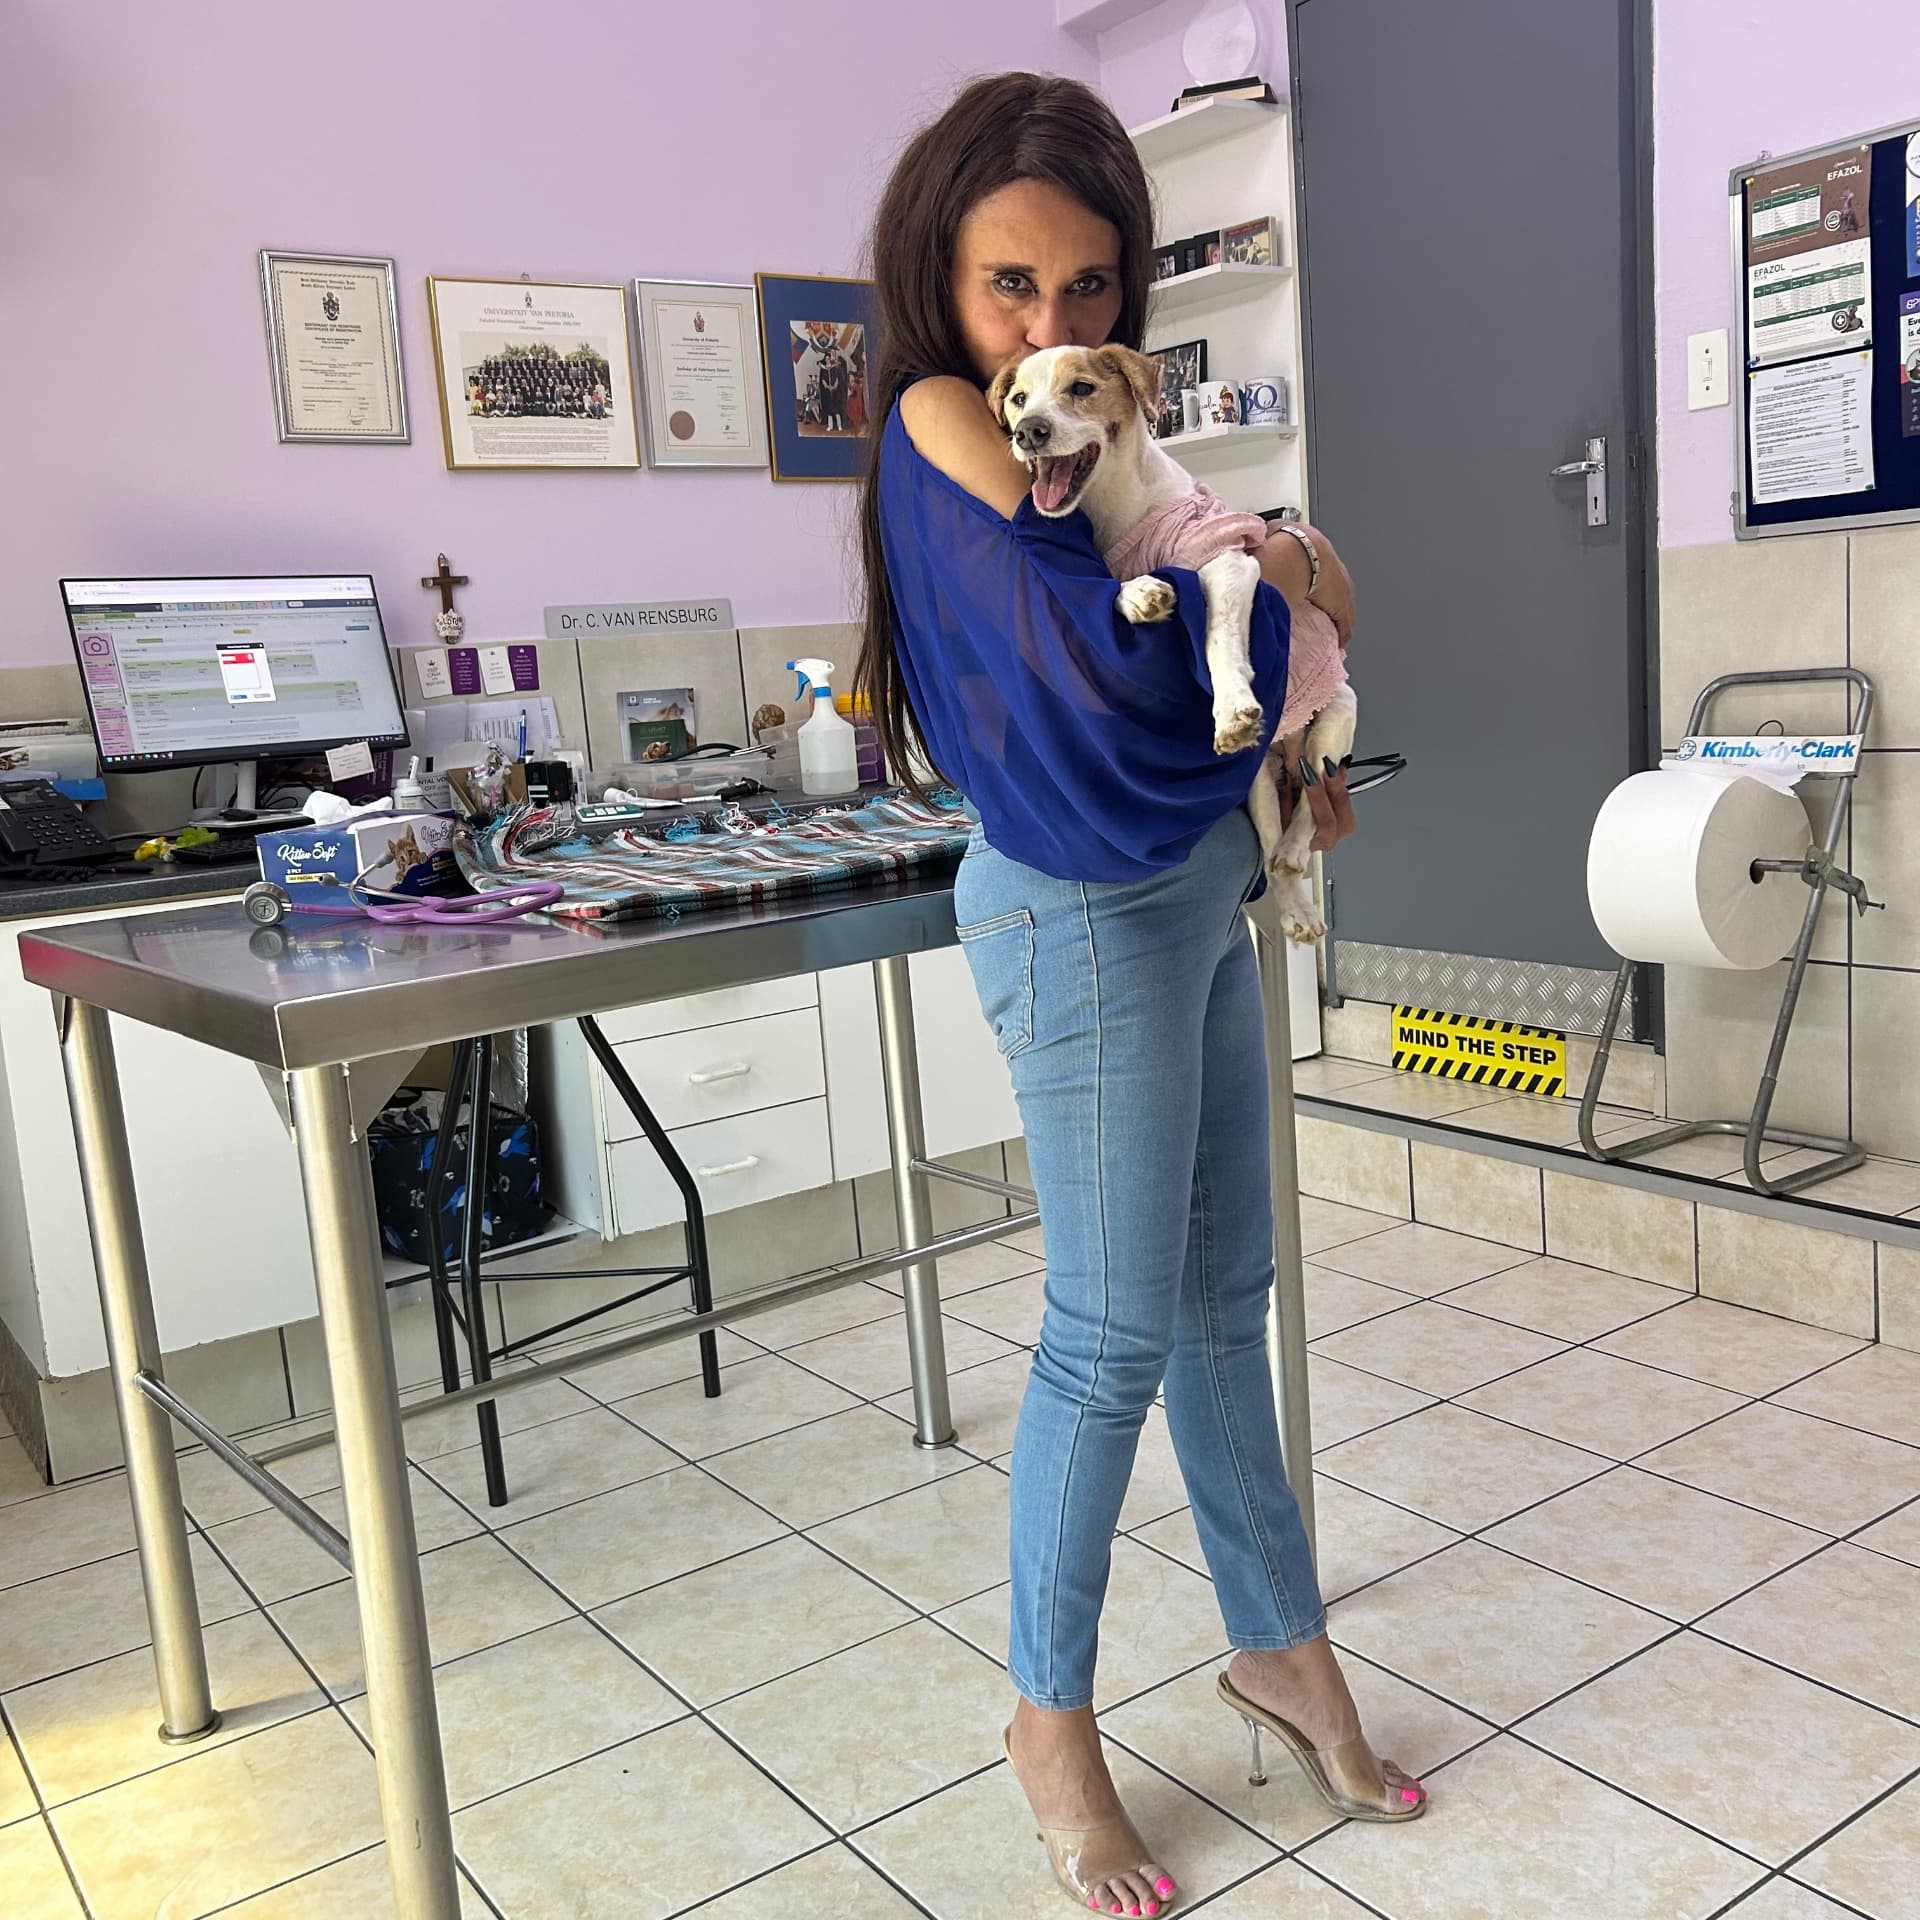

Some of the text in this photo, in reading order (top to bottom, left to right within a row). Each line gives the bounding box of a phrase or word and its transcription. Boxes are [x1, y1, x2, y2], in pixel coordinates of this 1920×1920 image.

[1827, 165, 1863, 181] EFAZOL
[1754, 264, 1786, 278] EFAZOL
[561, 607, 718, 629] Dr. C. VAN RENSBURG
[1399, 1027, 1557, 1066] MIND THE STEP
